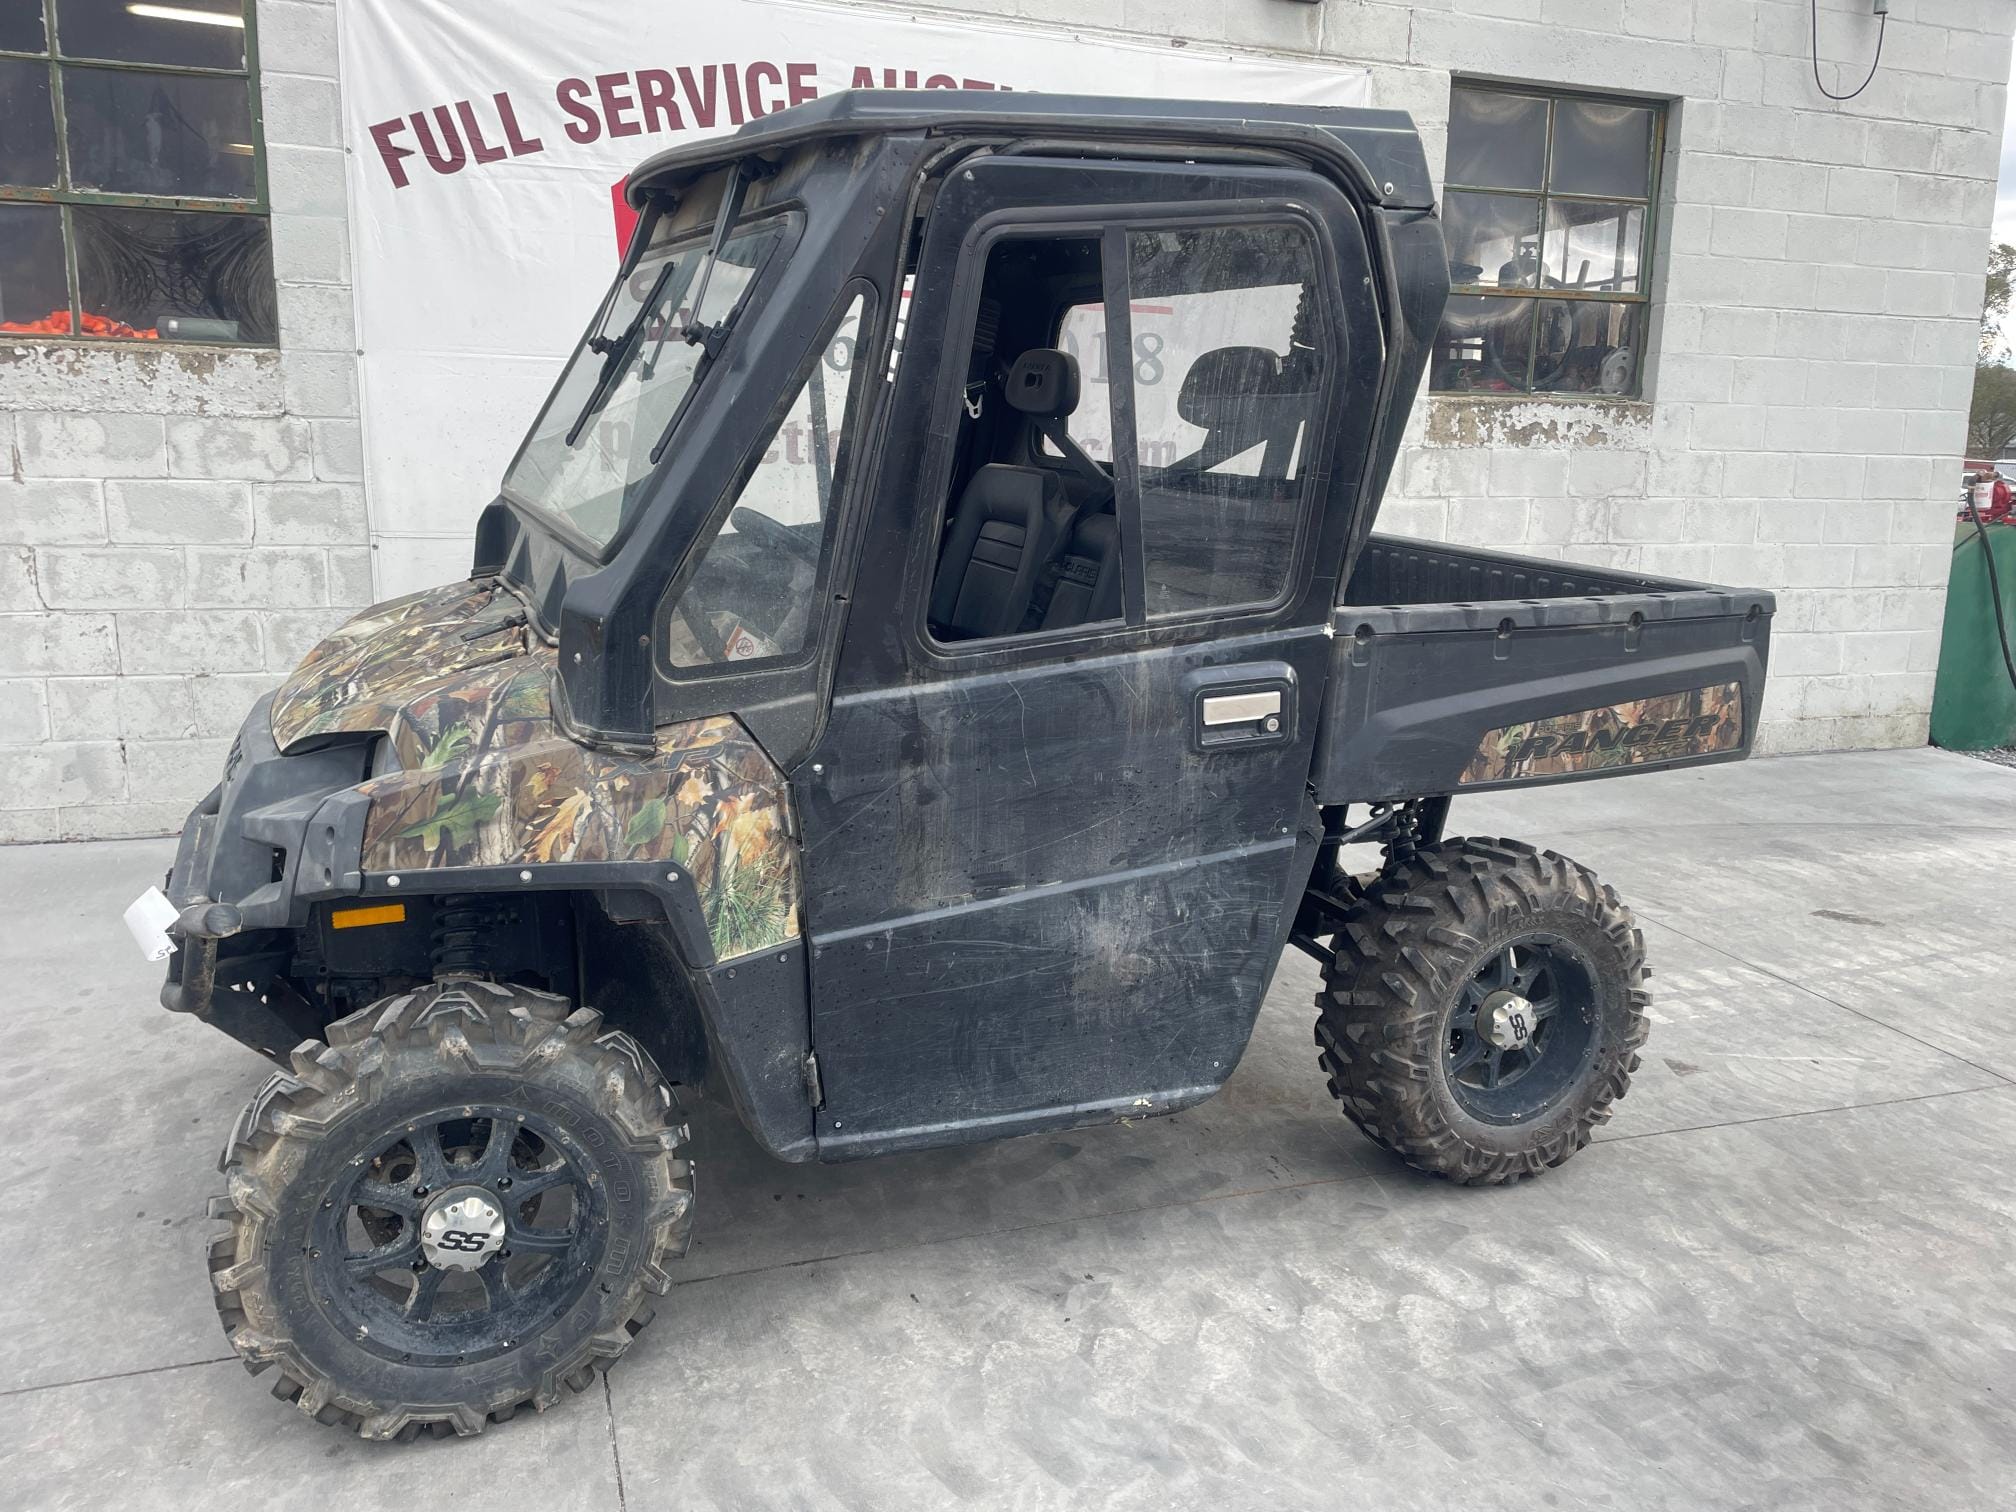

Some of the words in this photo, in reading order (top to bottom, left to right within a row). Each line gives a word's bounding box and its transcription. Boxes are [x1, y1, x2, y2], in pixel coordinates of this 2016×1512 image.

[368, 92, 544, 189] FULL
[556, 62, 818, 144] SERVICE
[1512, 714, 1721, 762] RANGER
[1509, 1013, 1528, 1041] SS
[437, 1230, 490, 1252] SS
